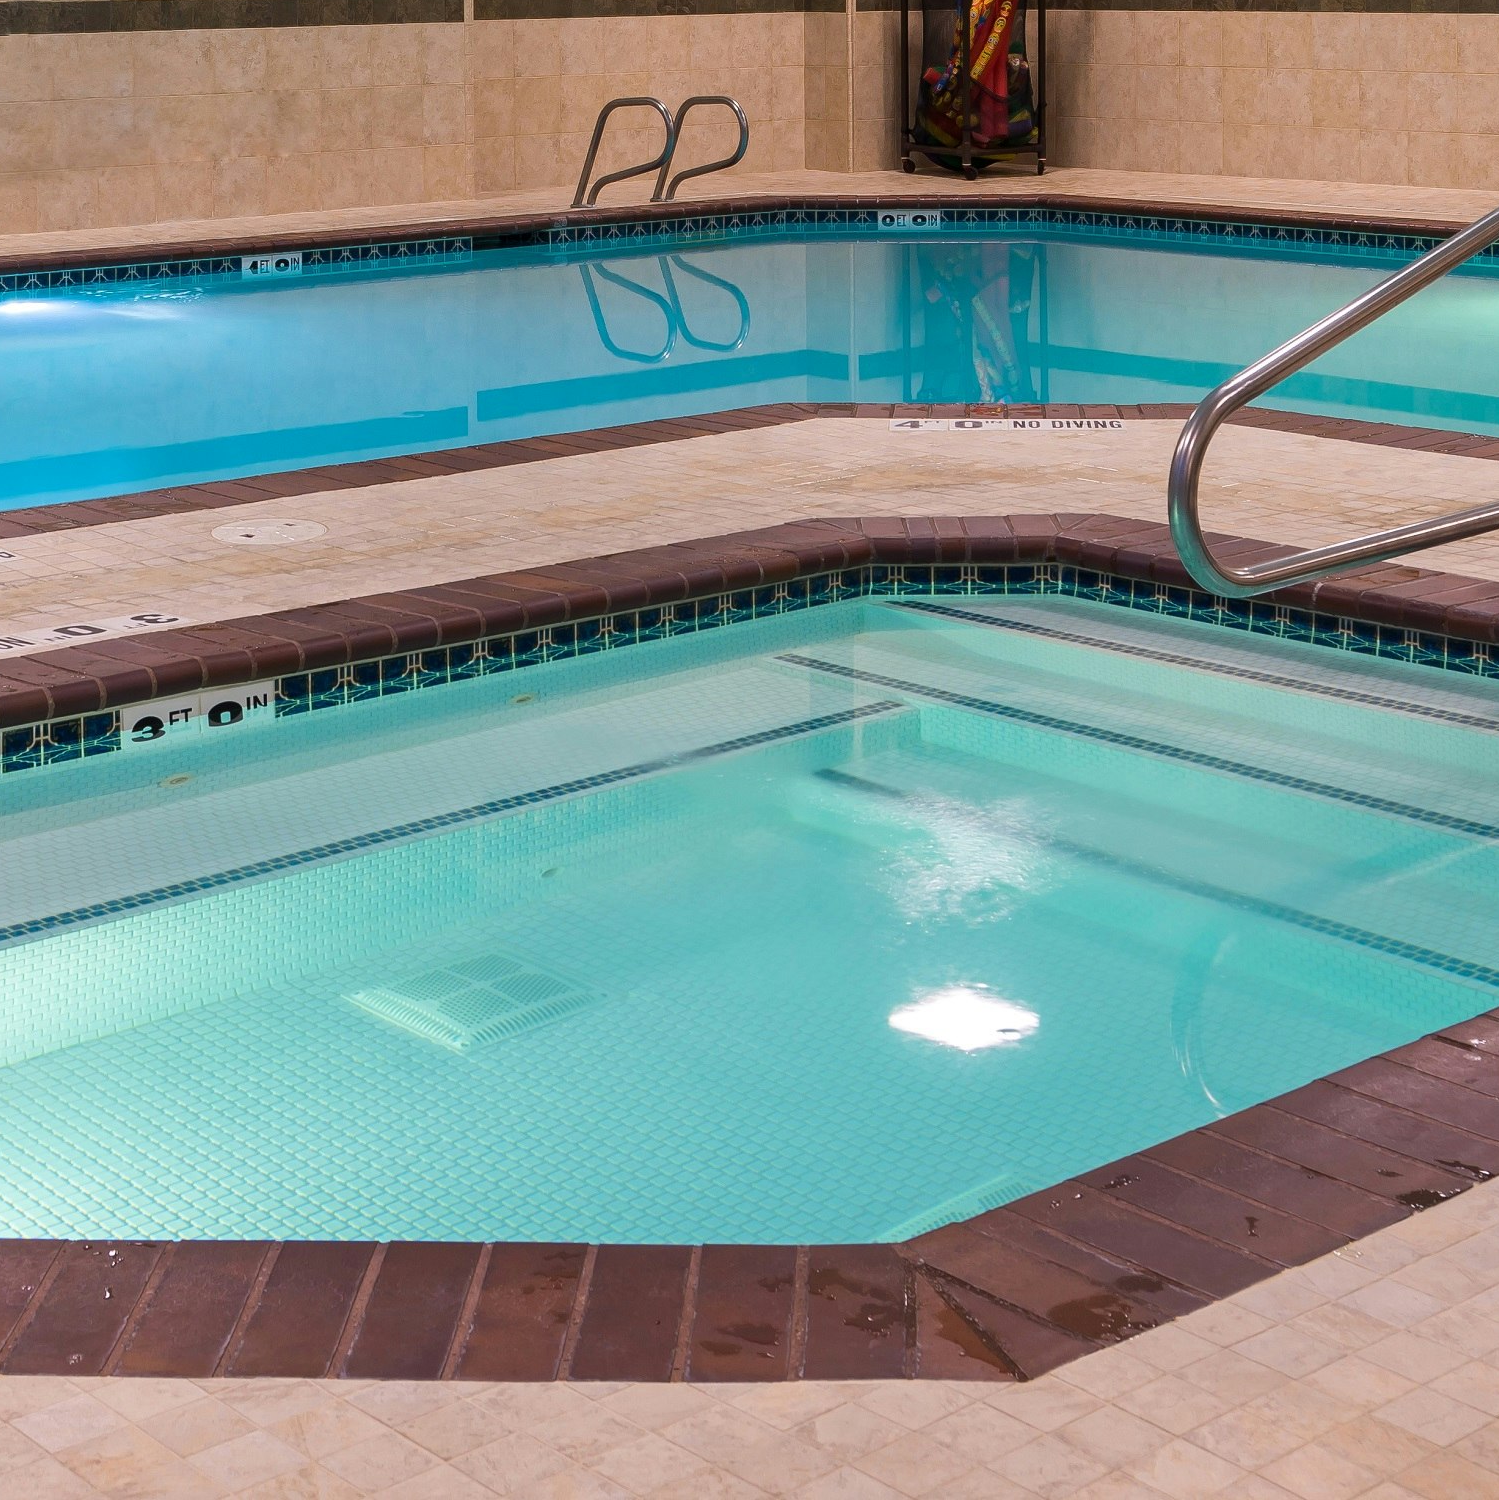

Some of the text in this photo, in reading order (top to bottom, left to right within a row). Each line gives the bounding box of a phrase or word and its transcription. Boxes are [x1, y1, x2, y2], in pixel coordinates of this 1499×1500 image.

[1013, 420, 1040, 429] NO
[1052, 420, 1122, 429] DIVING
[130, 614, 179, 624] 3
[52, 625, 107, 636] 0
[131, 694, 268, 742] 3 FT 0 IN
